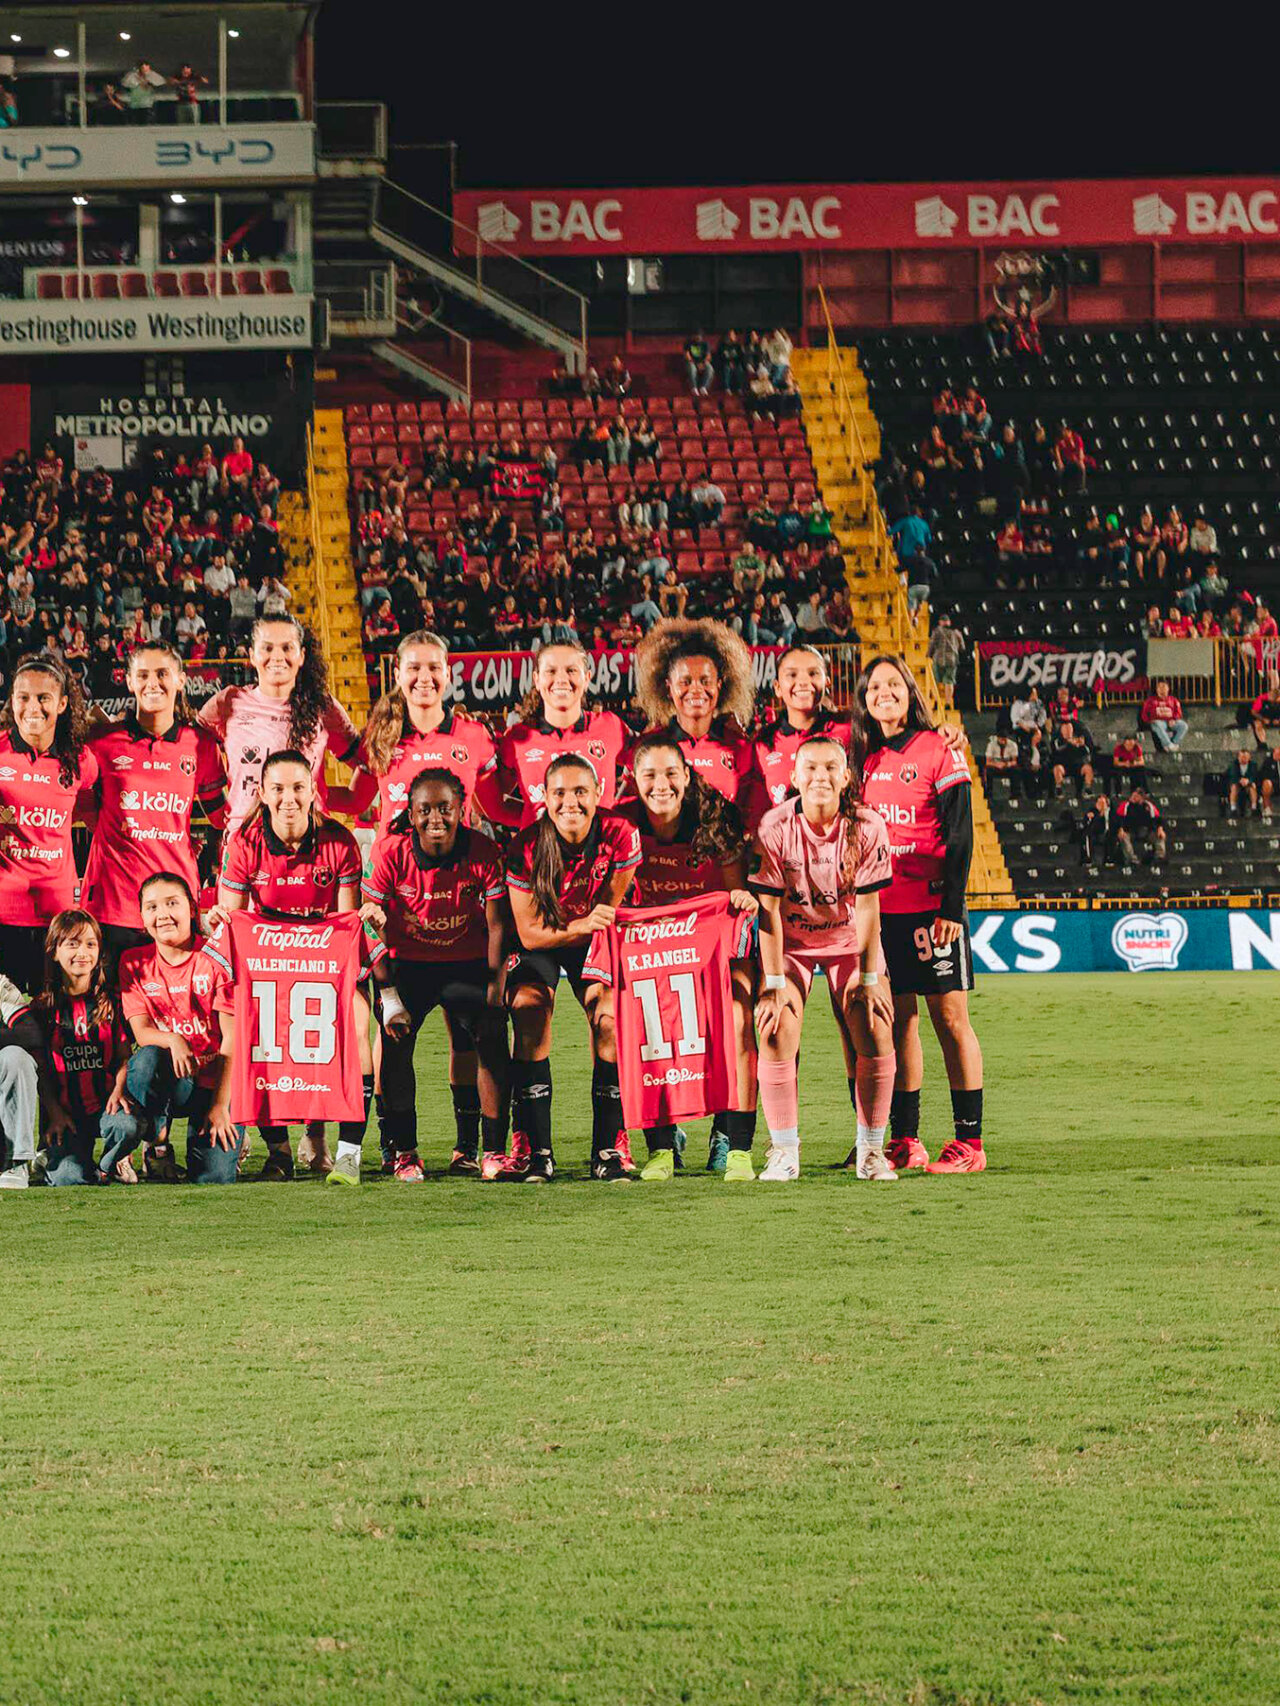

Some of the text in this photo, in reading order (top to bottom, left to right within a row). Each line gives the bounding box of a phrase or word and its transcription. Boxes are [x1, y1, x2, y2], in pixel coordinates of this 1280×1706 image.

[155, 139, 275, 166] BYD
[530, 200, 622, 242] BAC
[749, 196, 842, 240] BAC
[967, 194, 1060, 237] BAC
[1185, 192, 1279, 235] BAC
[148, 311, 305, 343] Westinghouse
[101, 398, 228, 415] HOSPITAL
[55, 414, 266, 438] METROPOLITANO
[471, 657, 512, 700] CON
[990, 650, 1137, 687] BUSETEROS
[153, 761, 172, 771] BAC
[423, 753, 443, 761] BAC
[694, 758, 714, 767] BAC
[33, 774, 51, 784] BAC
[142, 791, 191, 815] kölbi
[19, 806, 68, 829] kölbi
[287, 877, 306, 885] BAC
[433, 890, 453, 899] BAC
[252, 924, 334, 951] Tropical
[1124, 929, 1170, 939] NUTRI
[1125, 939, 1171, 949] SNACKS
[247, 958, 341, 974] VALENCIANO R.
[628, 948, 701, 972] K.RANGEL
[251, 980, 338, 1065] 18
[632, 972, 706, 1062] 11
[256, 1077, 331, 1091] Dos Pinos
